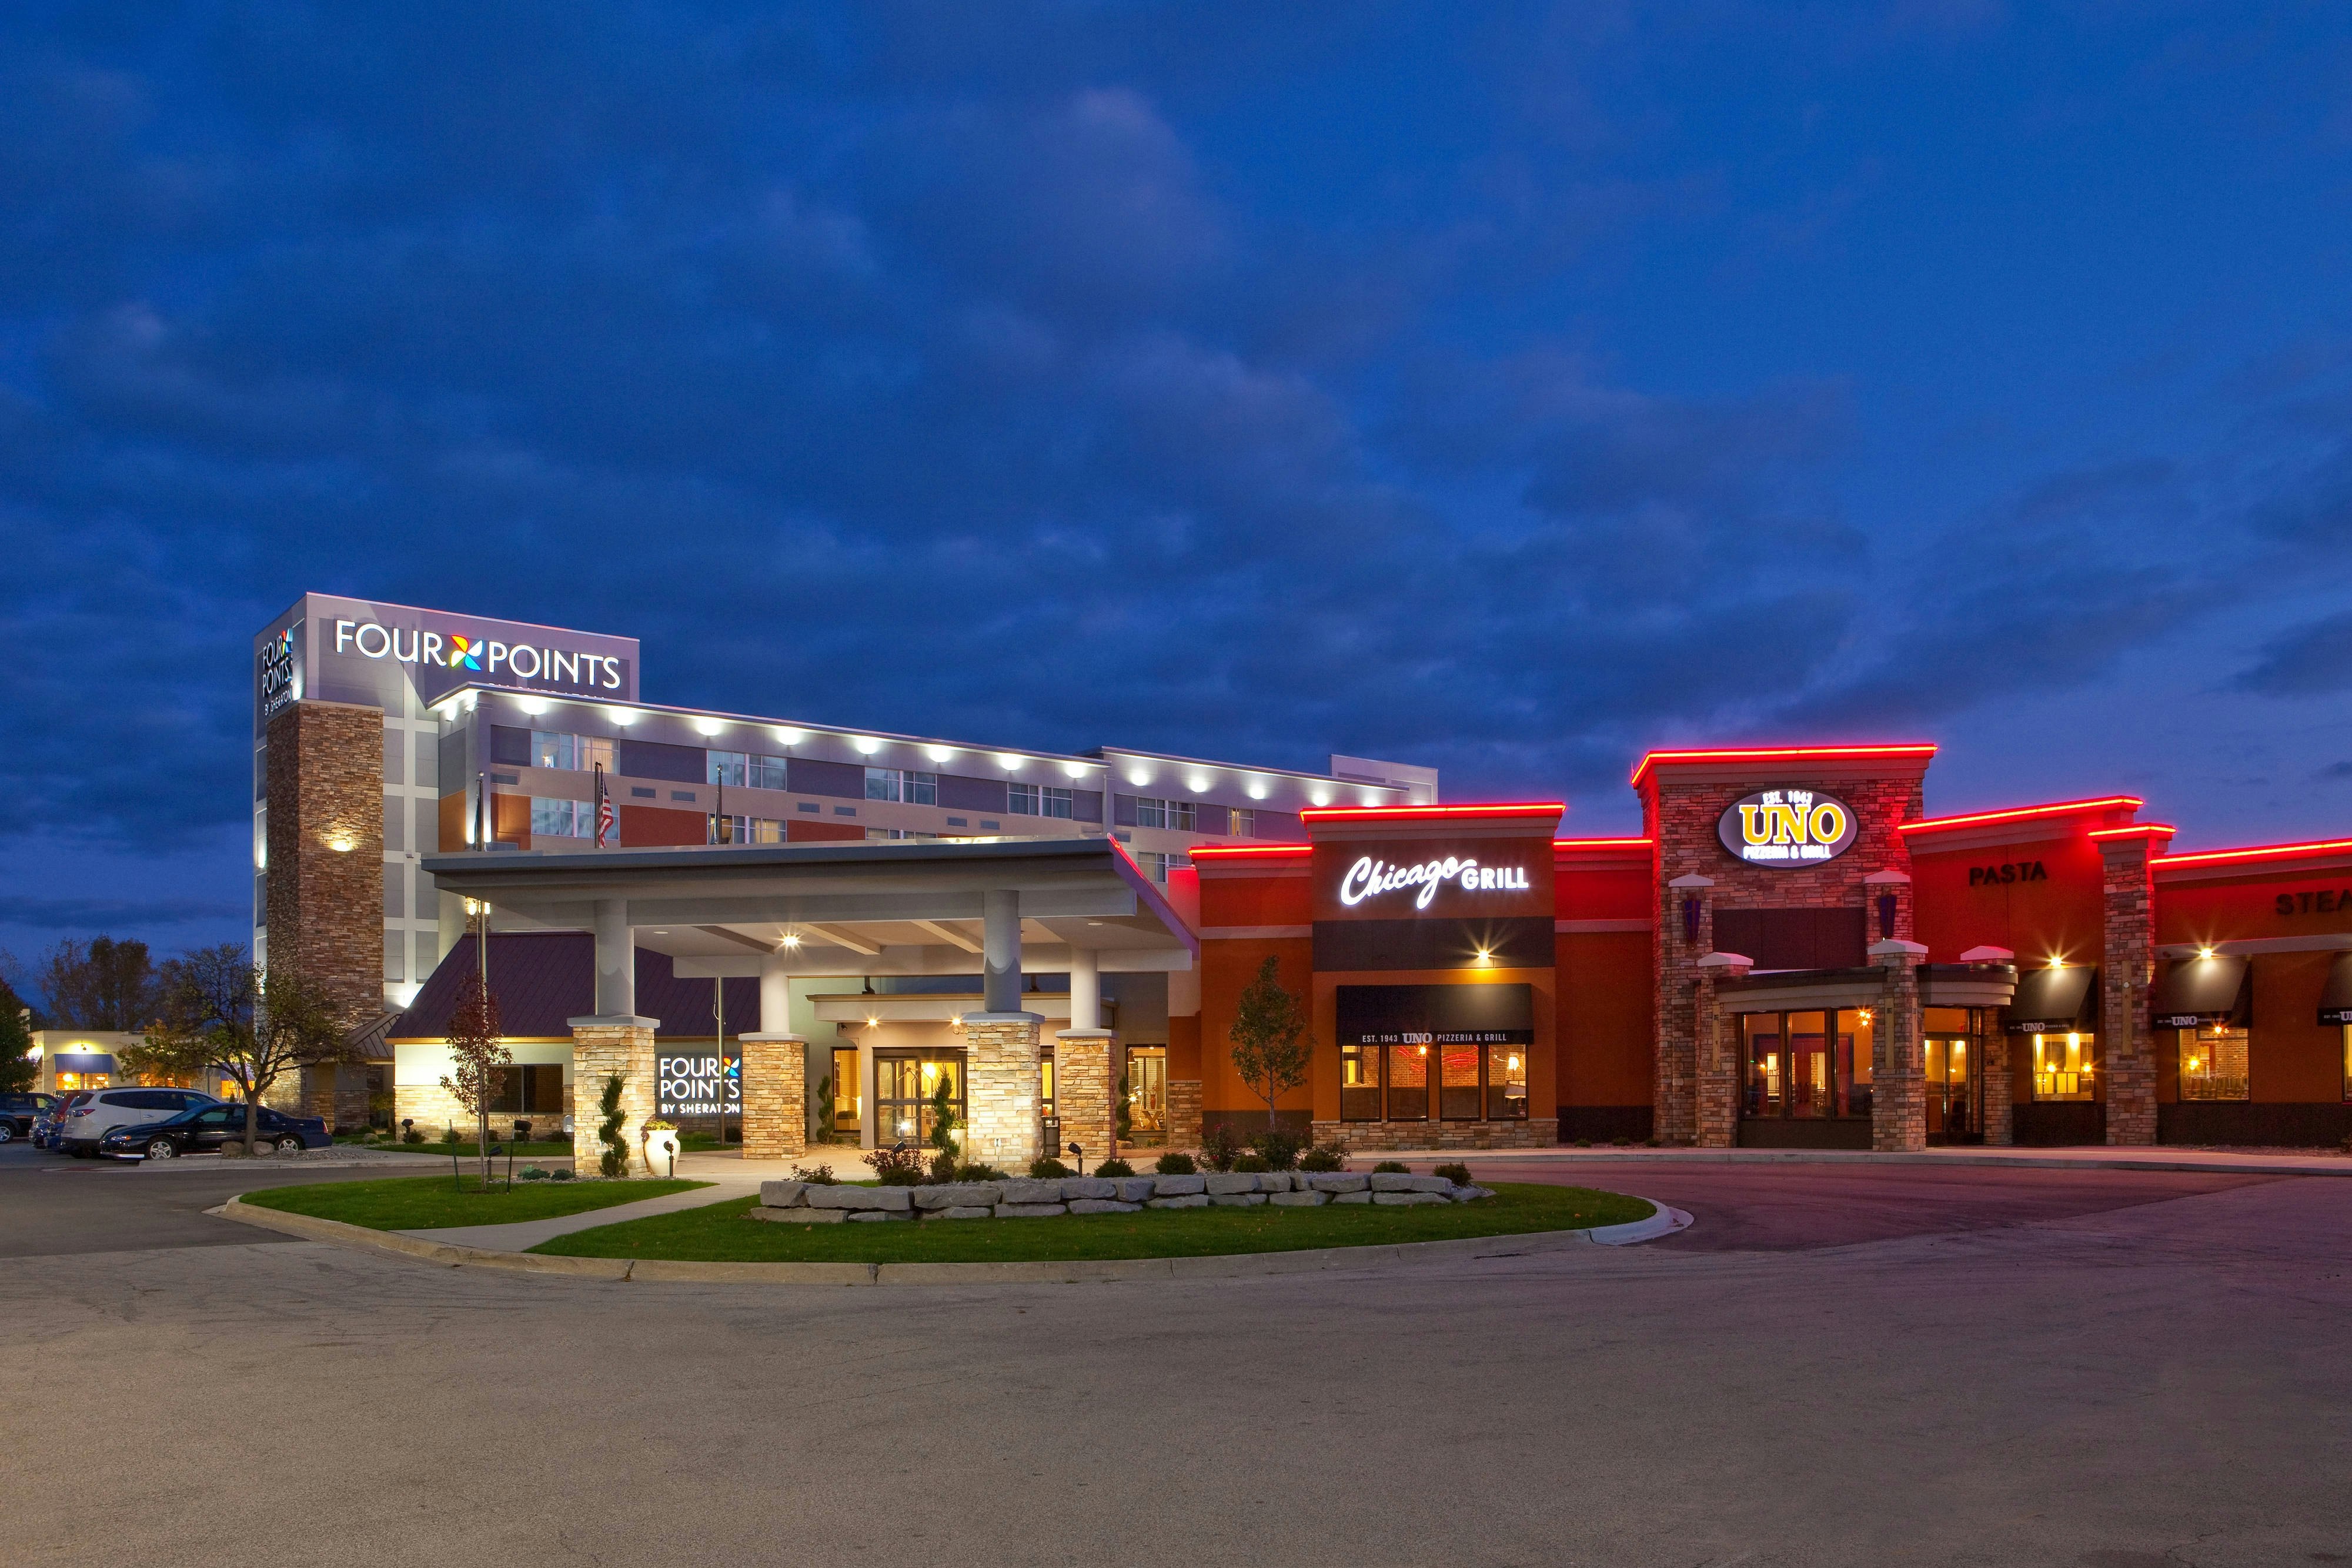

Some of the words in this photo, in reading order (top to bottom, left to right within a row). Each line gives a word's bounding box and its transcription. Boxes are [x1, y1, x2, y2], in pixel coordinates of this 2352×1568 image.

[263, 635, 283, 670] FOUR
[336, 620, 447, 667] FOUR
[489, 641, 621, 690] POINTS
[263, 656, 290, 697] POINTS
[265, 703, 269, 716] BY
[270, 688, 292, 712] SHERATON
[1739, 803, 1846, 845] UNO
[1341, 856, 1477, 910] Chicago
[1461, 867, 1529, 890] GRILL
[1969, 861, 2047, 886] PASTA
[2022, 1022, 2045, 1032] UNO
[2171, 1016, 2197, 1026] UNO
[1402, 1032, 1433, 1044] UNO
[660, 1057, 720, 1078] FOUR
[661, 1103, 676, 1114] BY
